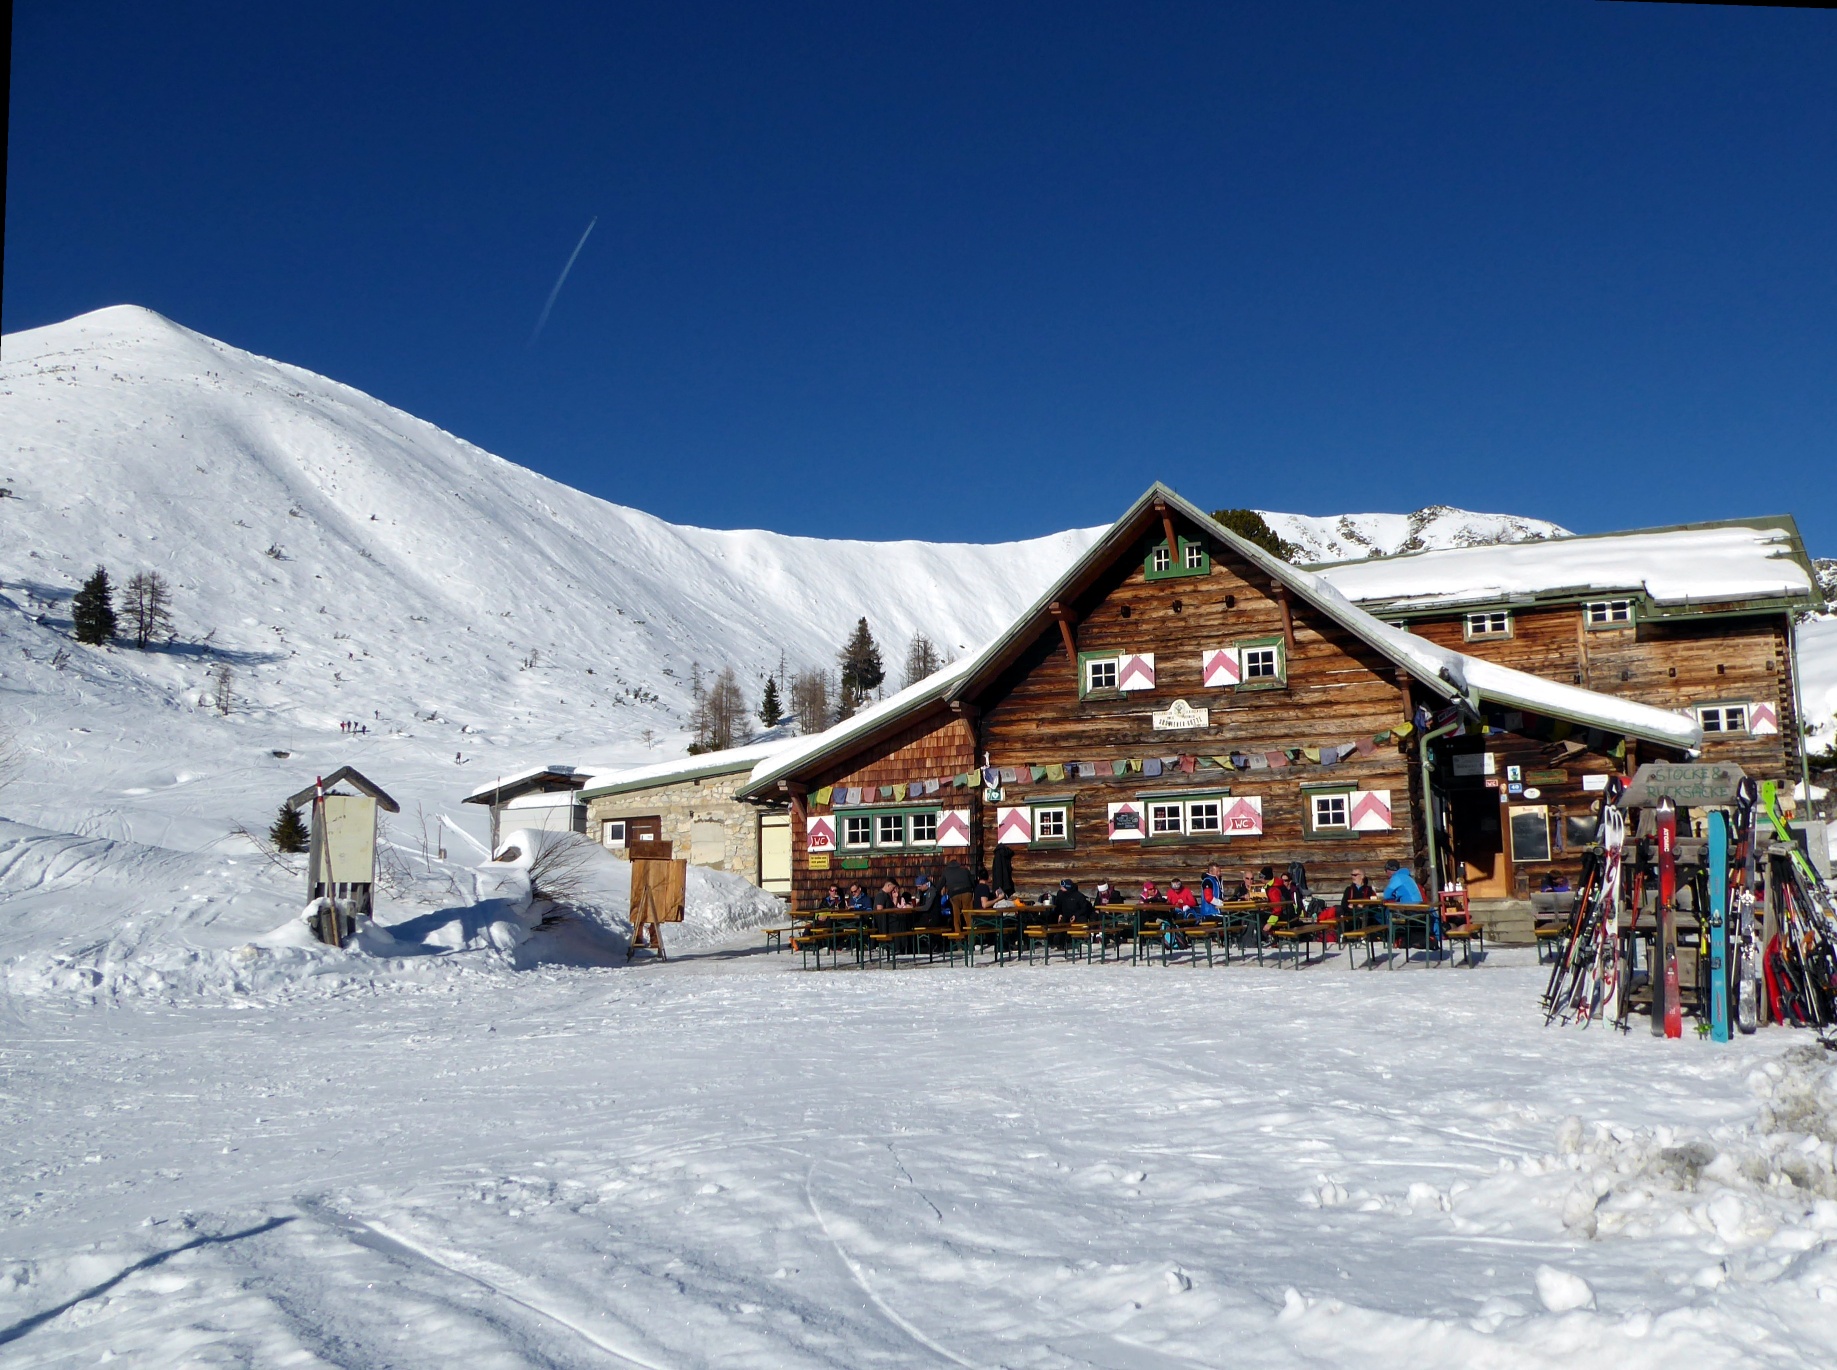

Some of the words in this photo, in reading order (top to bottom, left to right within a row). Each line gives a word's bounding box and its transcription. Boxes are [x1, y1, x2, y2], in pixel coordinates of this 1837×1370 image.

[1712, 767, 1721, 779] &
[1234, 819, 1249, 829] WC
[814, 837, 826, 846] WC
